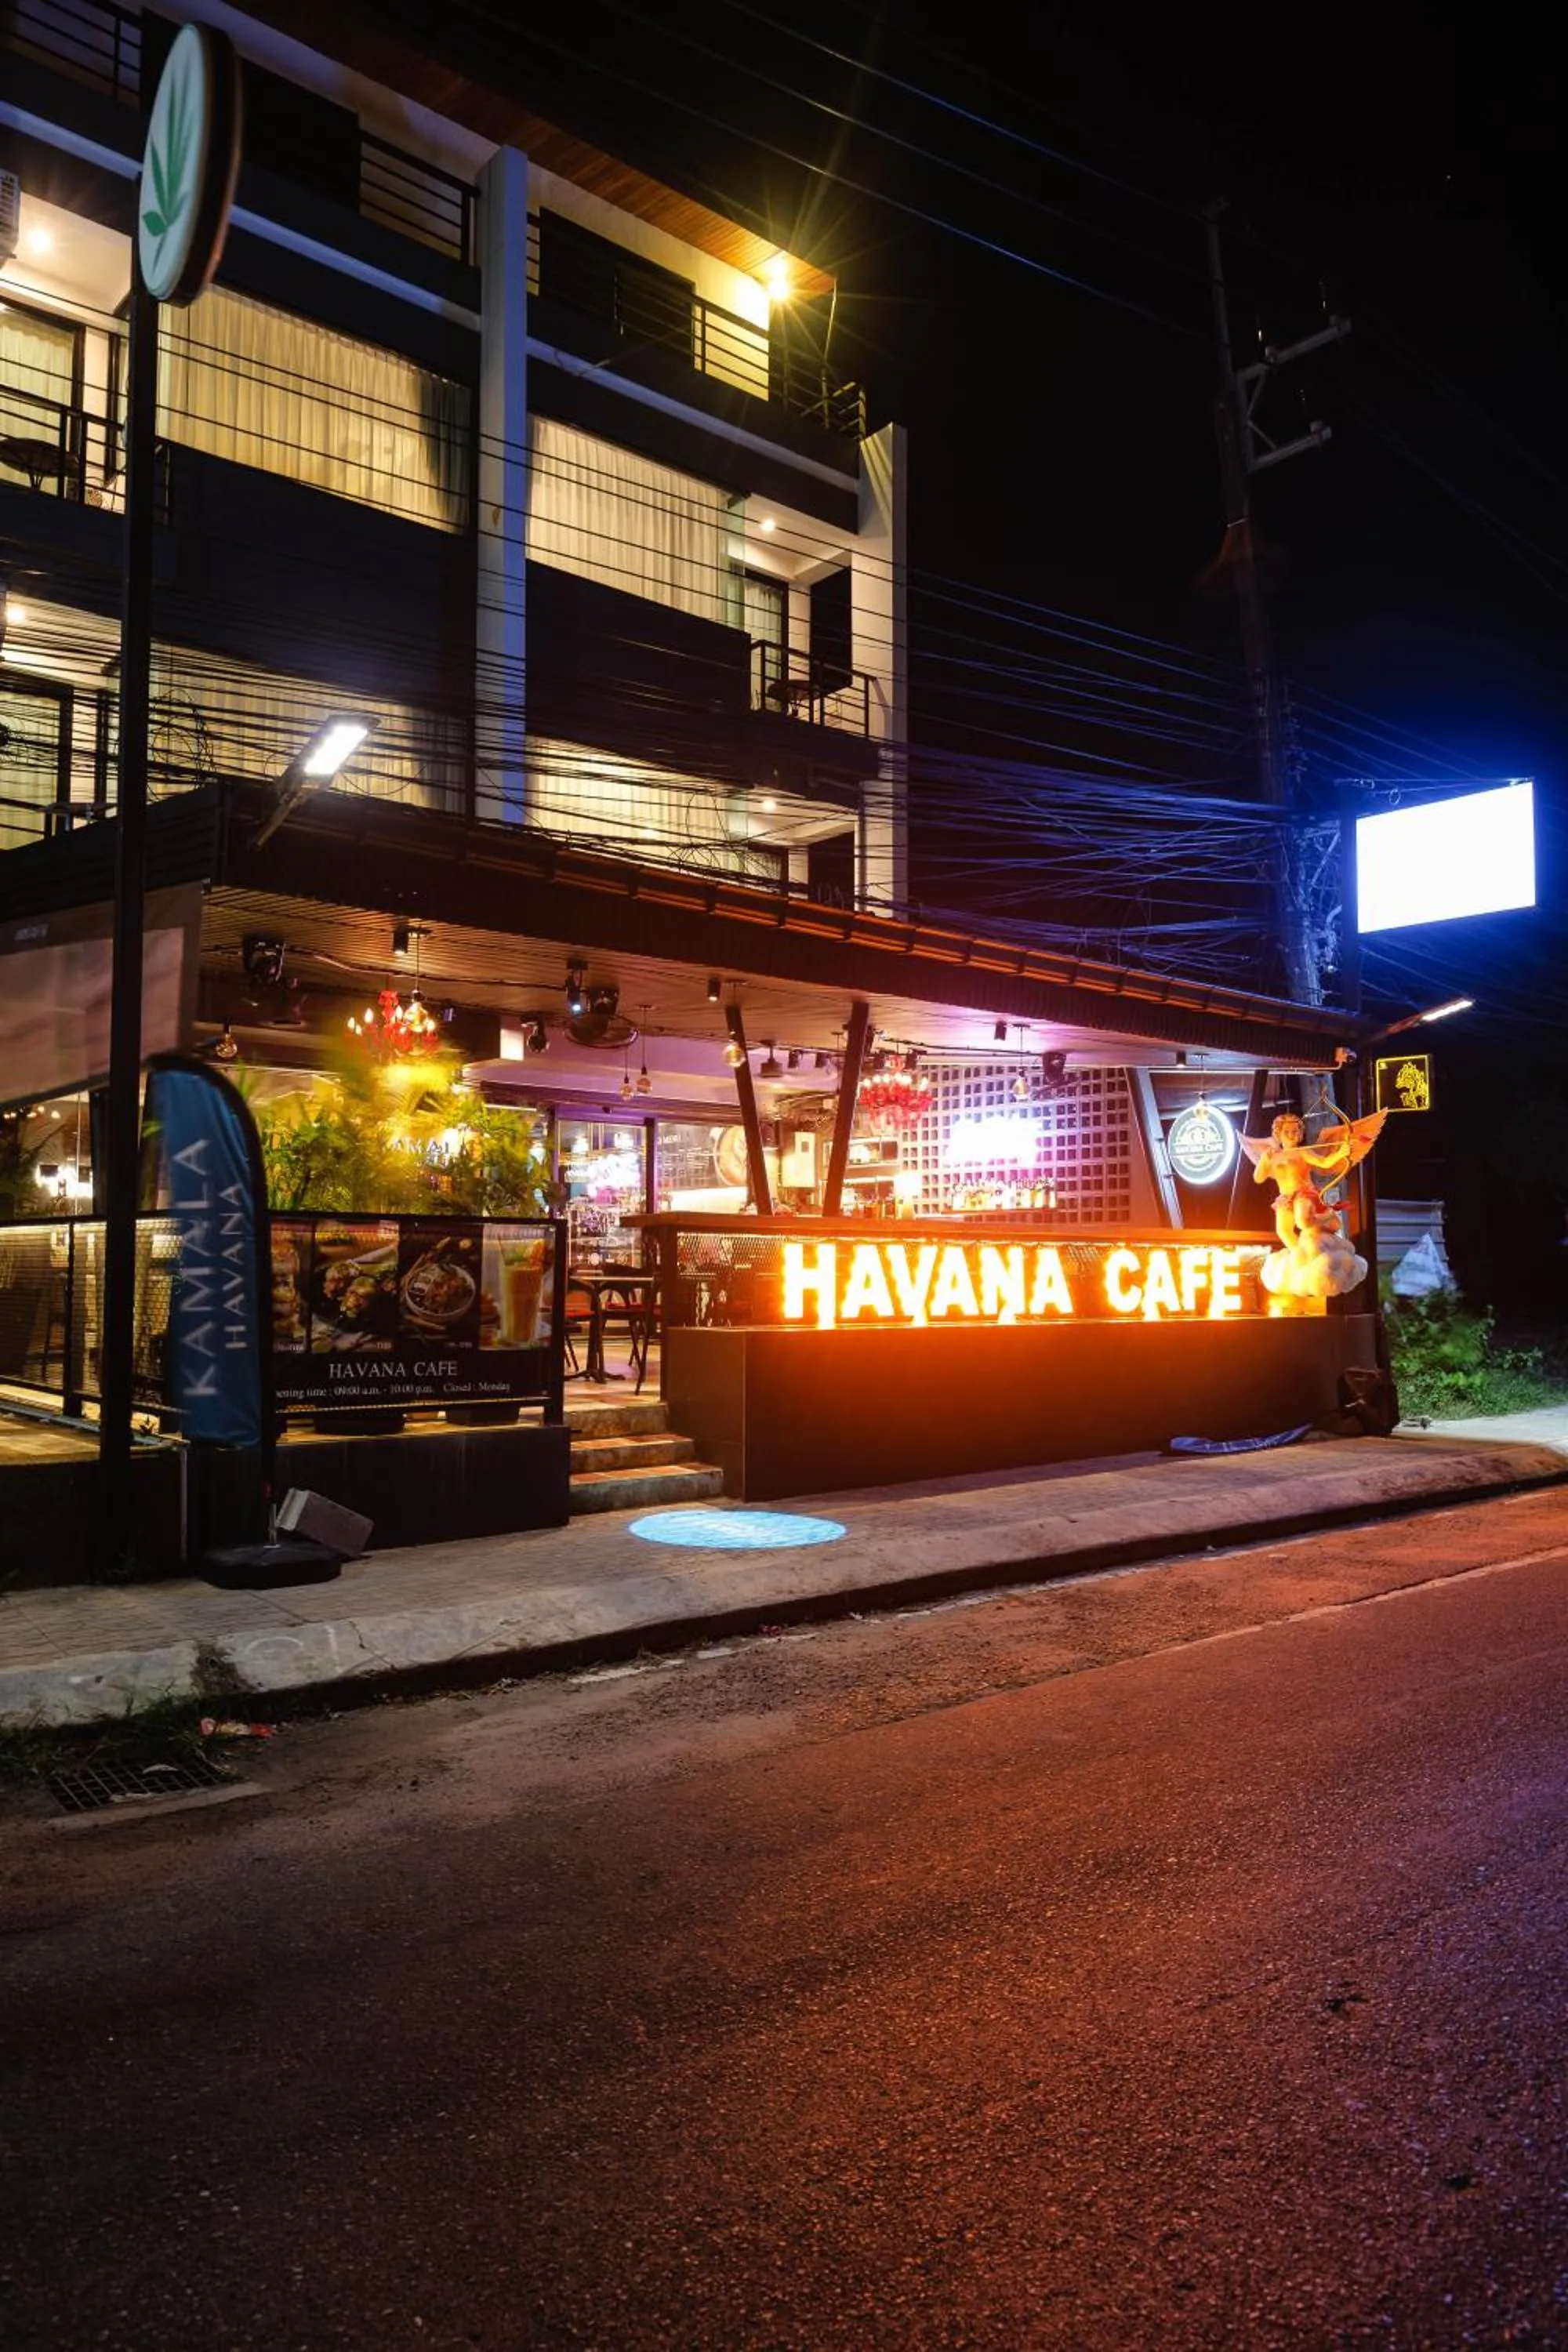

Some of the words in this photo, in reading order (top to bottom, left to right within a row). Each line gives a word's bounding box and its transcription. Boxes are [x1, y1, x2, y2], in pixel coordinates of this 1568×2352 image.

[172, 1138, 219, 1396] KAMALA
[219, 1182, 248, 1349] HAVANA
[782, 1243, 1074, 1325] HAVANA
[1103, 1247, 1243, 1319] CAFE
[329, 1360, 407, 1380] HAVANA
[413, 1359, 459, 1377] CAFE
[477, 1381, 510, 1394] Monday
